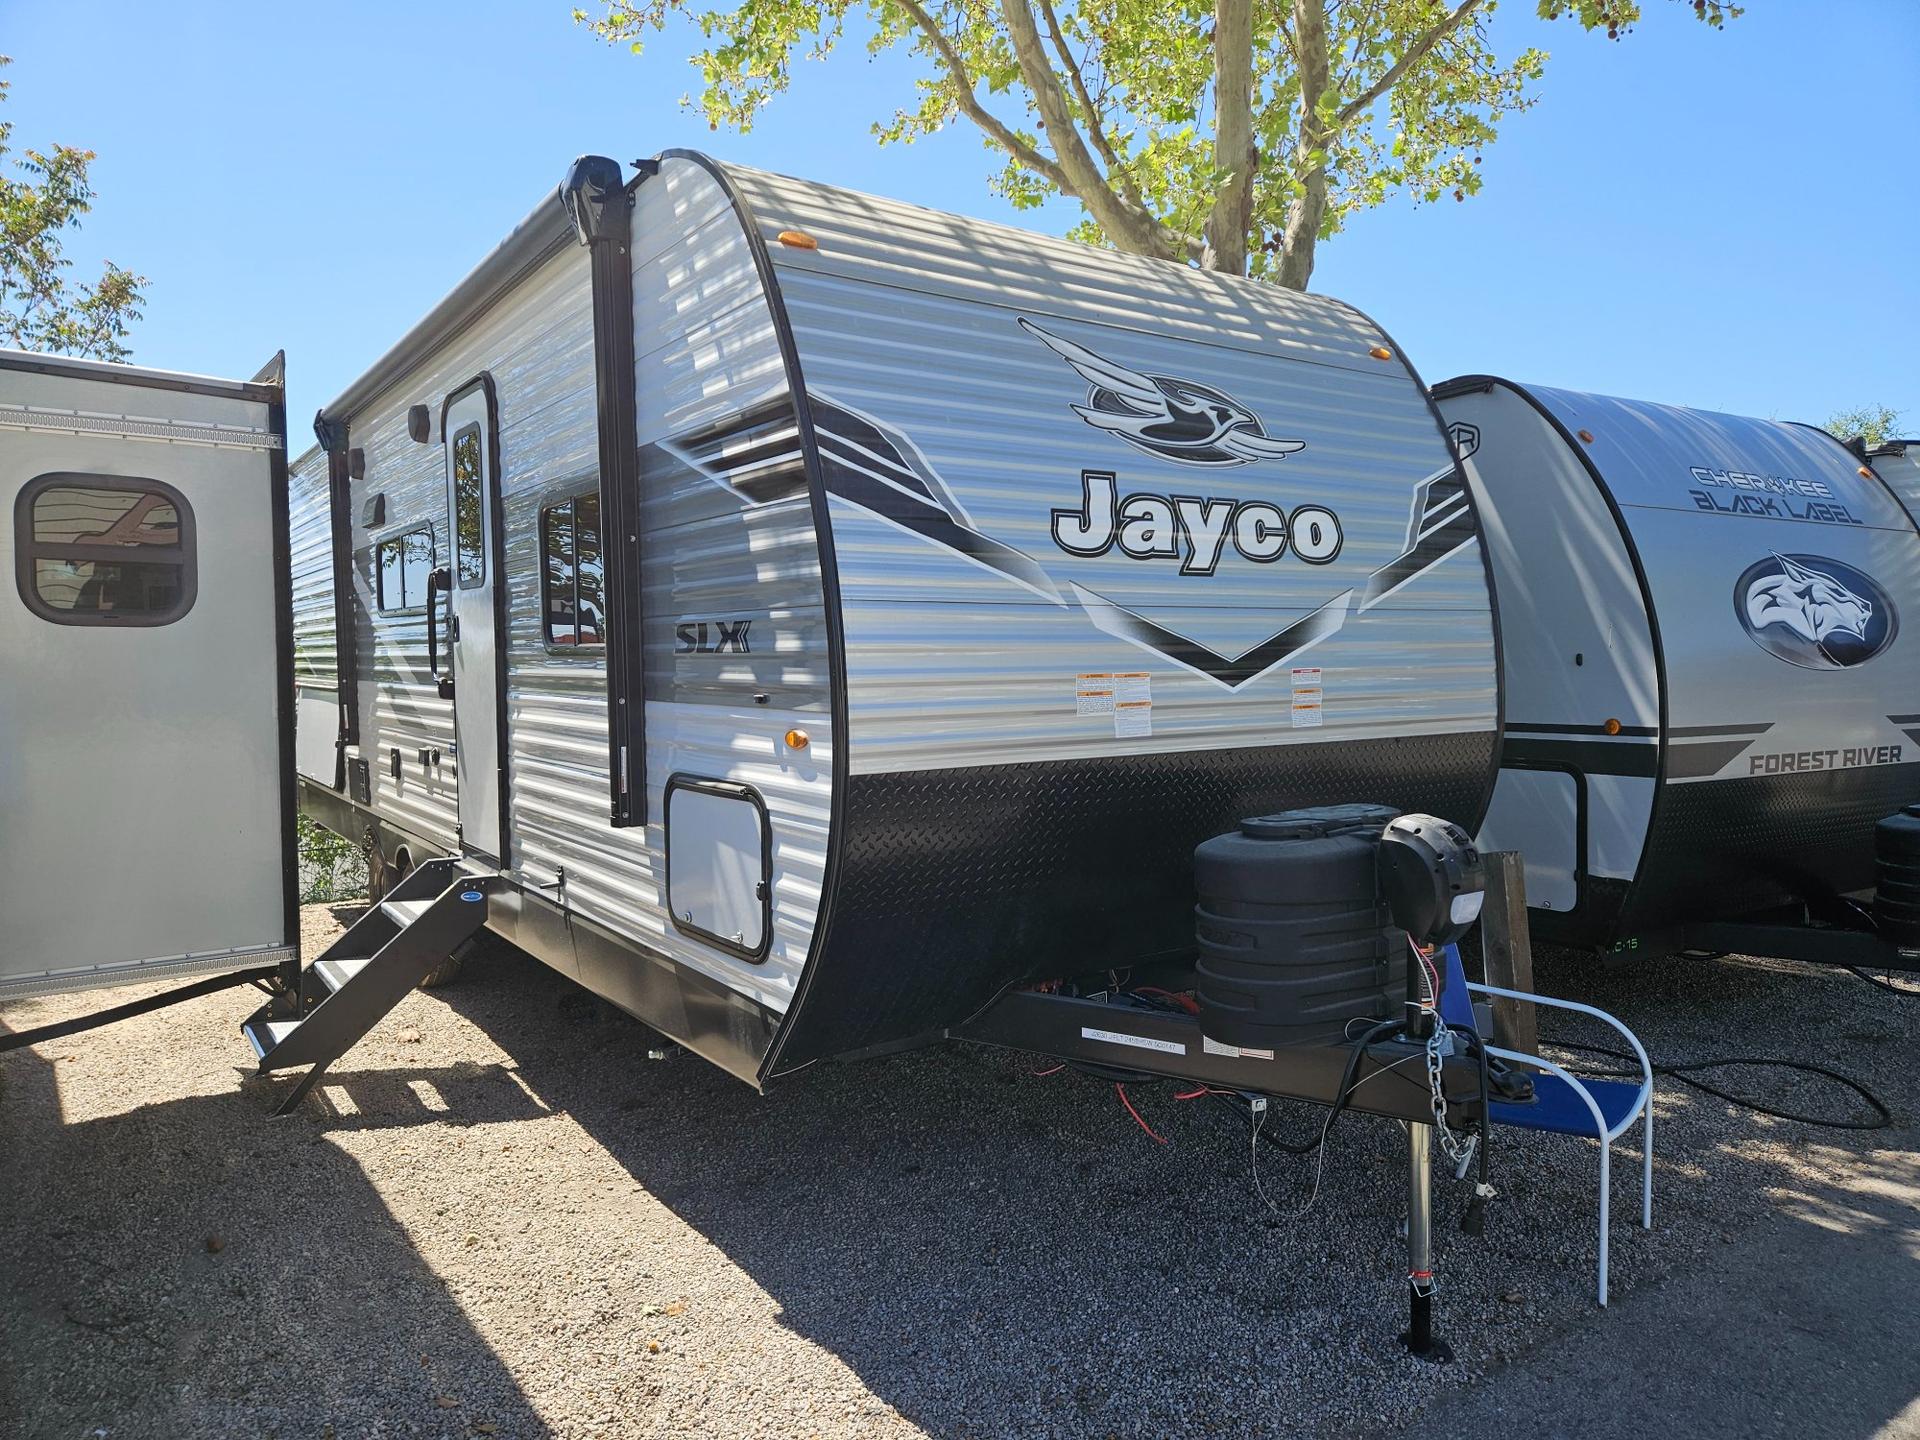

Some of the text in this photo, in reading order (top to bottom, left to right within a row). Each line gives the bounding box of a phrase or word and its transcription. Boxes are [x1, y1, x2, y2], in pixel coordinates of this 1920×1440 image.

[1690, 466, 1835, 500] CHEROKEE
[1050, 469, 1344, 577] Jayco
[1688, 489, 1864, 525] BLACK LABEL
[674, 620, 752, 654] SLX
[1749, 745, 1902, 775] FOREST RIVER
